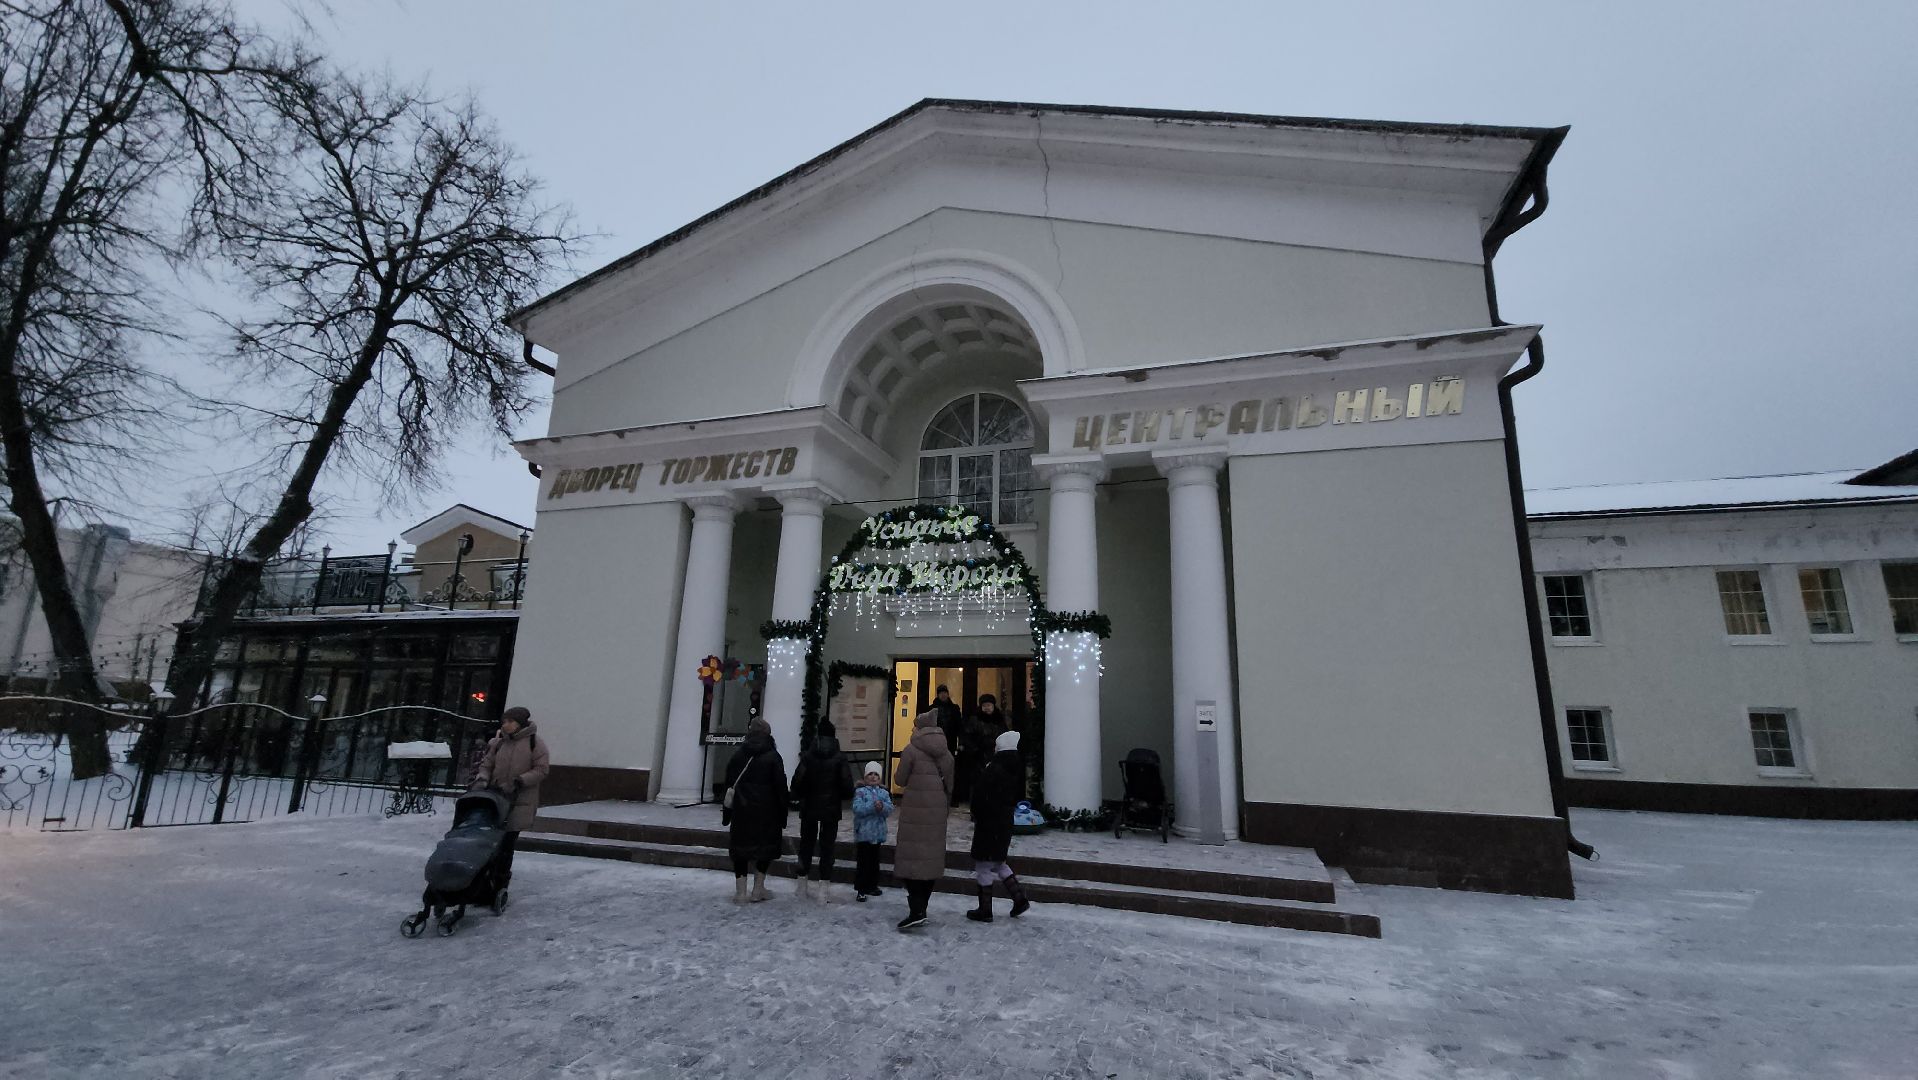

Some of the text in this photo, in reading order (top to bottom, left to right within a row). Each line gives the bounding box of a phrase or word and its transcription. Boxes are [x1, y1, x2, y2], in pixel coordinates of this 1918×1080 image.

[1073, 376, 1466, 452] ЦЕНТРАЛЬНЫЙ
[548, 447, 798, 499] ДВОРЕЦ ТОРЖЕСТВ
